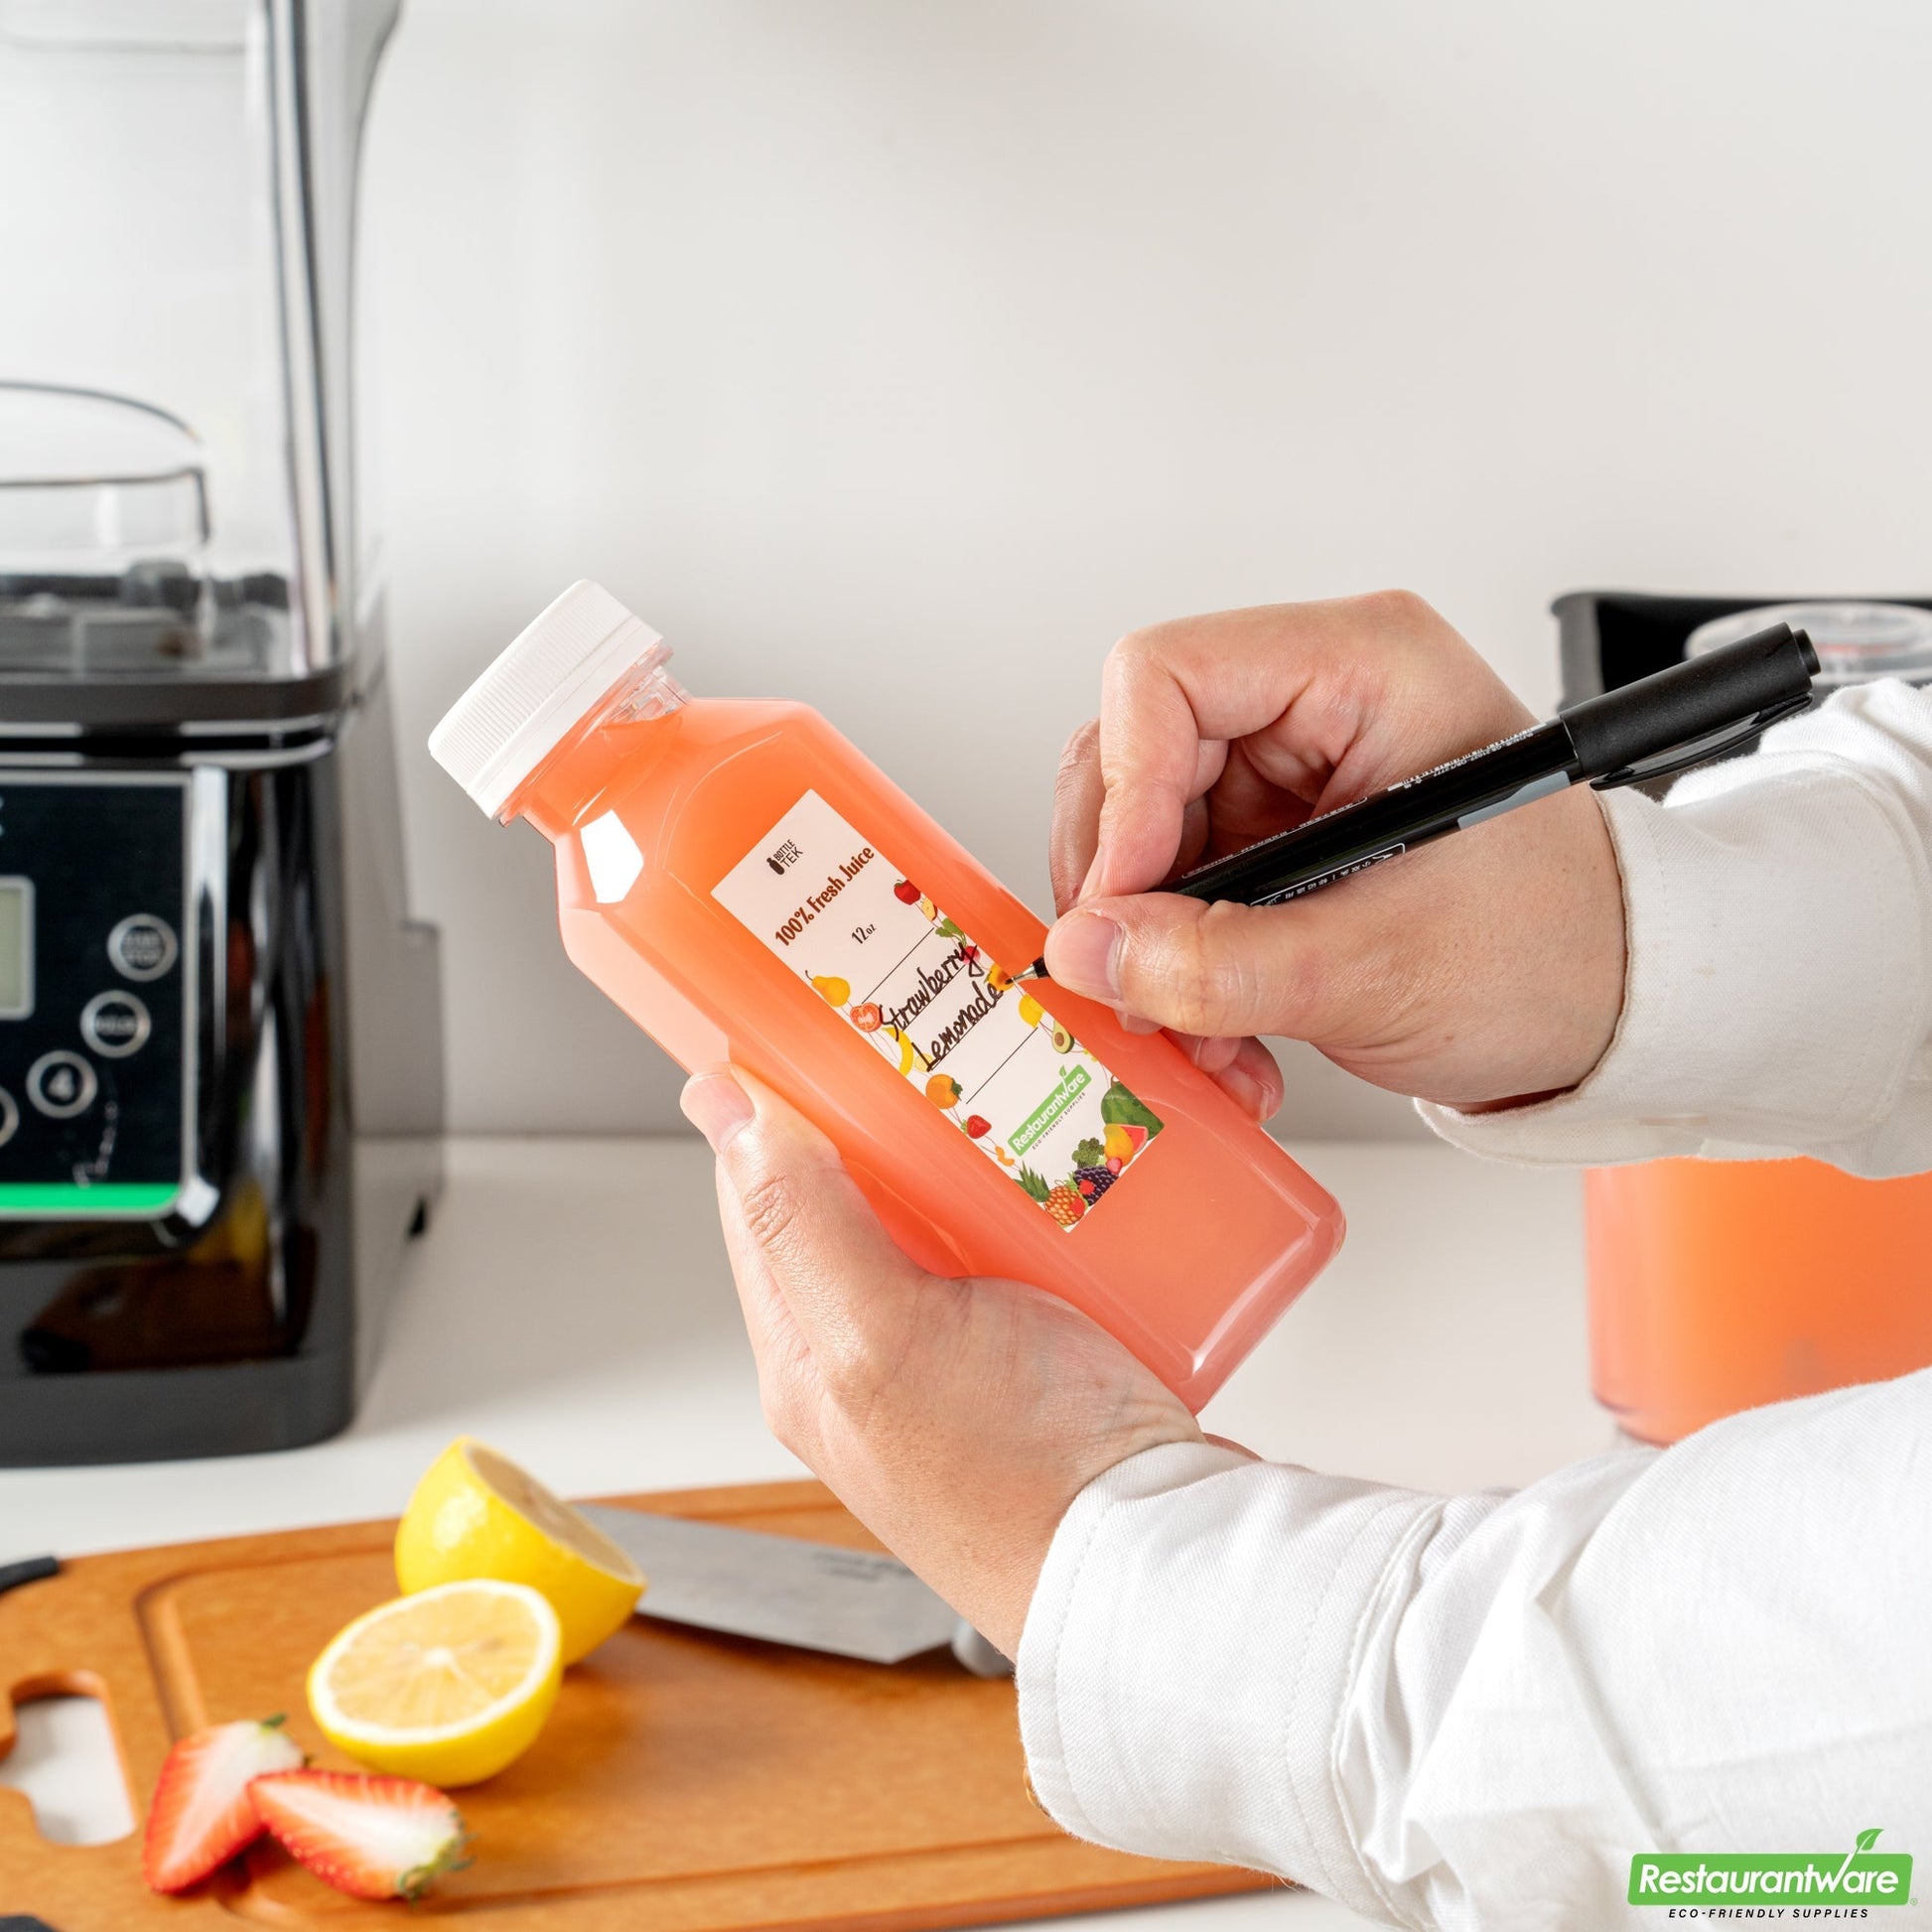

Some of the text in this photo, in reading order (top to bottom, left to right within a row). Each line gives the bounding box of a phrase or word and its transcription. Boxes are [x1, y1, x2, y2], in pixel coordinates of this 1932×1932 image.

[773, 839, 795, 860] BOTTLE
[780, 846, 803, 869] TEK
[775, 847, 875, 946] 100% Fresh Juice
[879, 942, 984, 1041] Strawberry
[911, 981, 1004, 1072] Lemonade
[1013, 1071, 1086, 1152] Restaurantware
